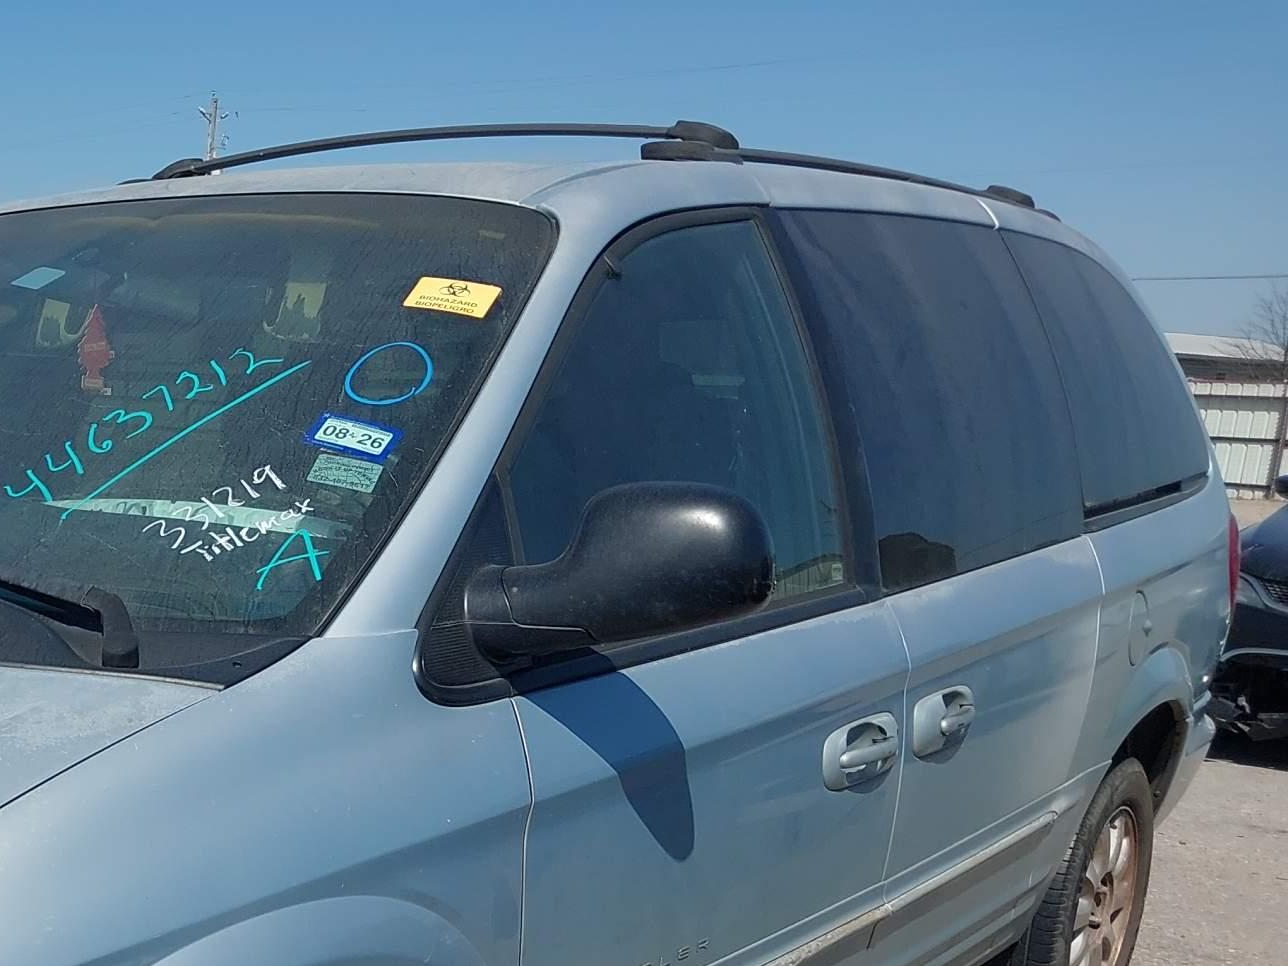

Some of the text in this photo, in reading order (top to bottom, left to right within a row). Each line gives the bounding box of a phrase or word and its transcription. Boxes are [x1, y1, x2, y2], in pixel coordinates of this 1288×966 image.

[414, 300, 475, 314] BIOPELIGRO
[418, 294, 478, 308] BIOHAZARD
[4, 348, 284, 503] 44637212
[322, 425, 350, 439] 08
[356, 433, 385, 449] 26
[256, 528, 329, 591] A
